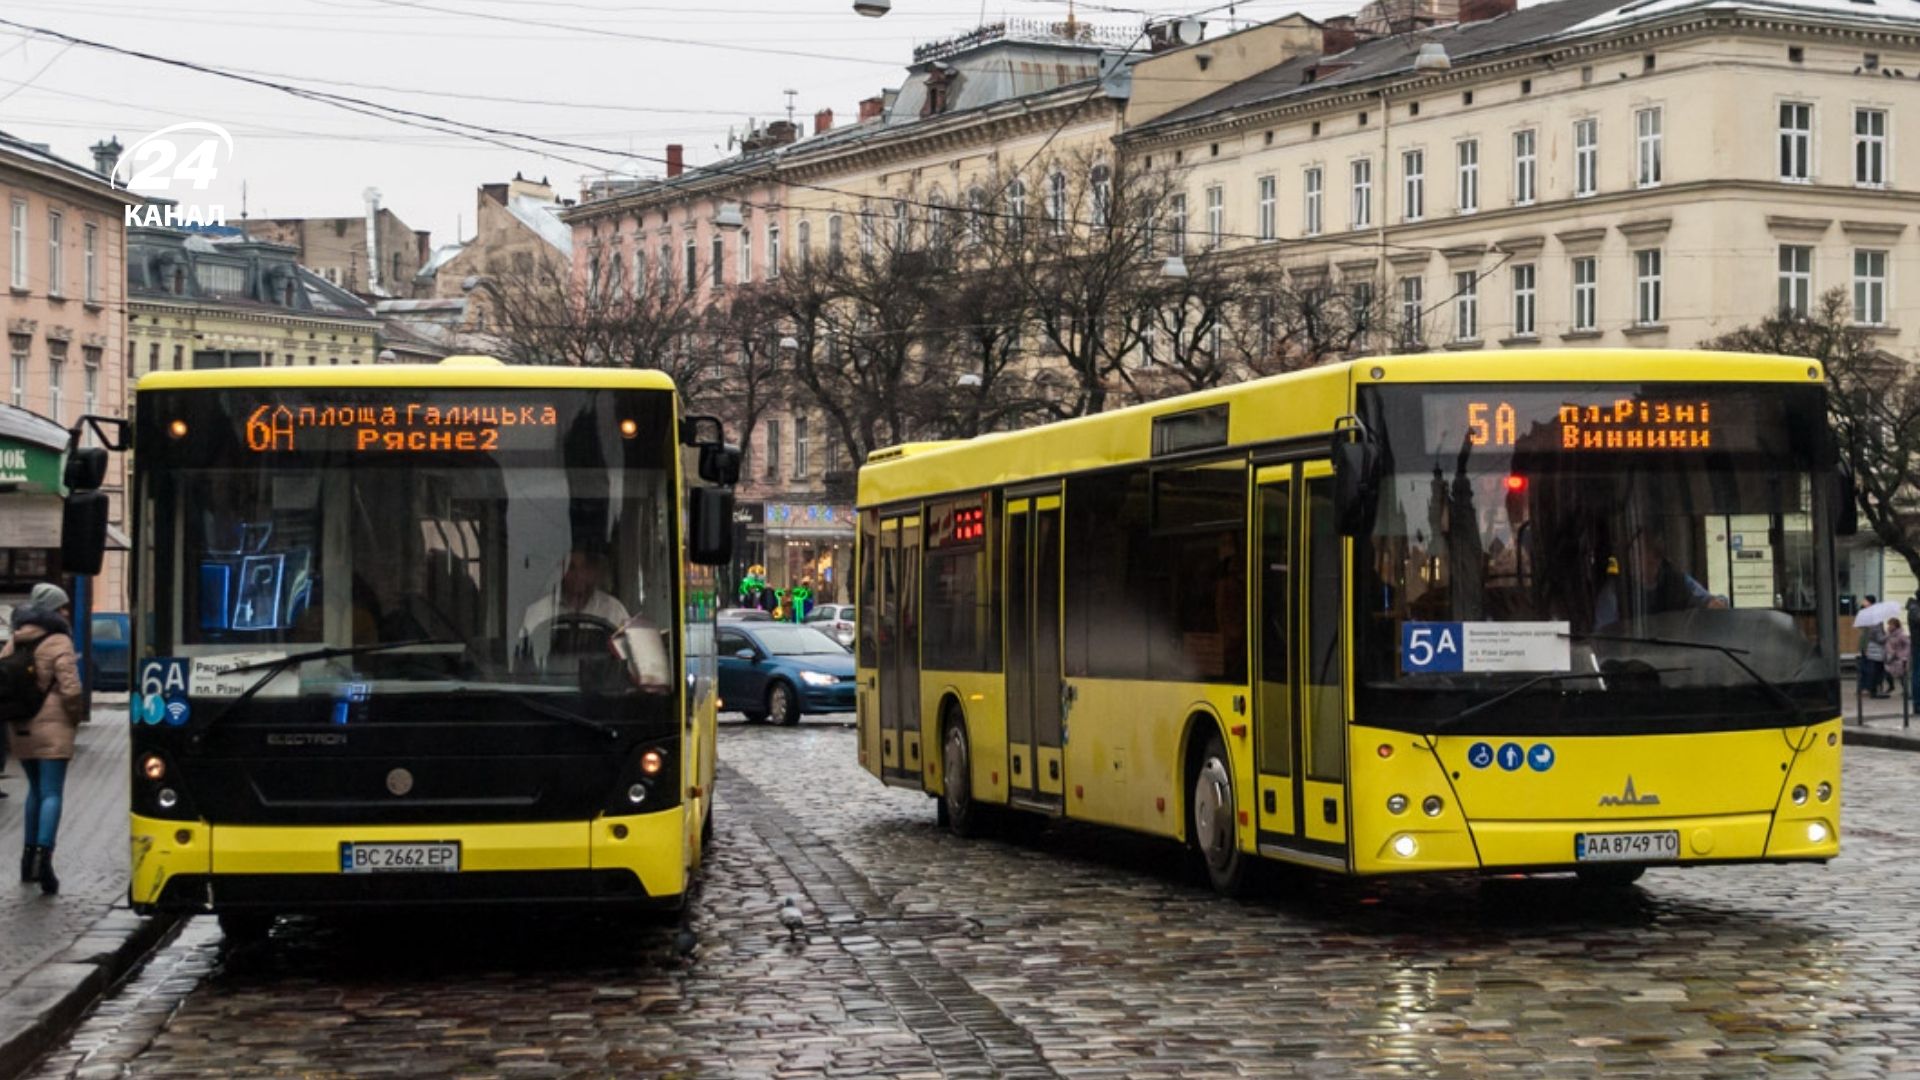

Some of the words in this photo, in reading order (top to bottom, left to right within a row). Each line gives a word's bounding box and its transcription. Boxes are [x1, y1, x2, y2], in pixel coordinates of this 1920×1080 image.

[300, 405, 397, 426] площа
[407, 404, 557, 426] Галицька
[1468, 403, 1516, 445] 5А
[247, 405, 294, 451] 6А
[357, 429, 499, 450] Рясне2
[1562, 425, 1709, 448] Винники
[1409, 629, 1457, 666] 5А
[142, 661, 185, 697] 6А
[1588, 838, 1611, 854] AA
[1613, 836, 1651, 853] 8749
[1653, 834, 1677, 851] TO
[355, 849, 380, 866] BC
[384, 848, 425, 866] 2662
[428, 848, 453, 865] EP
